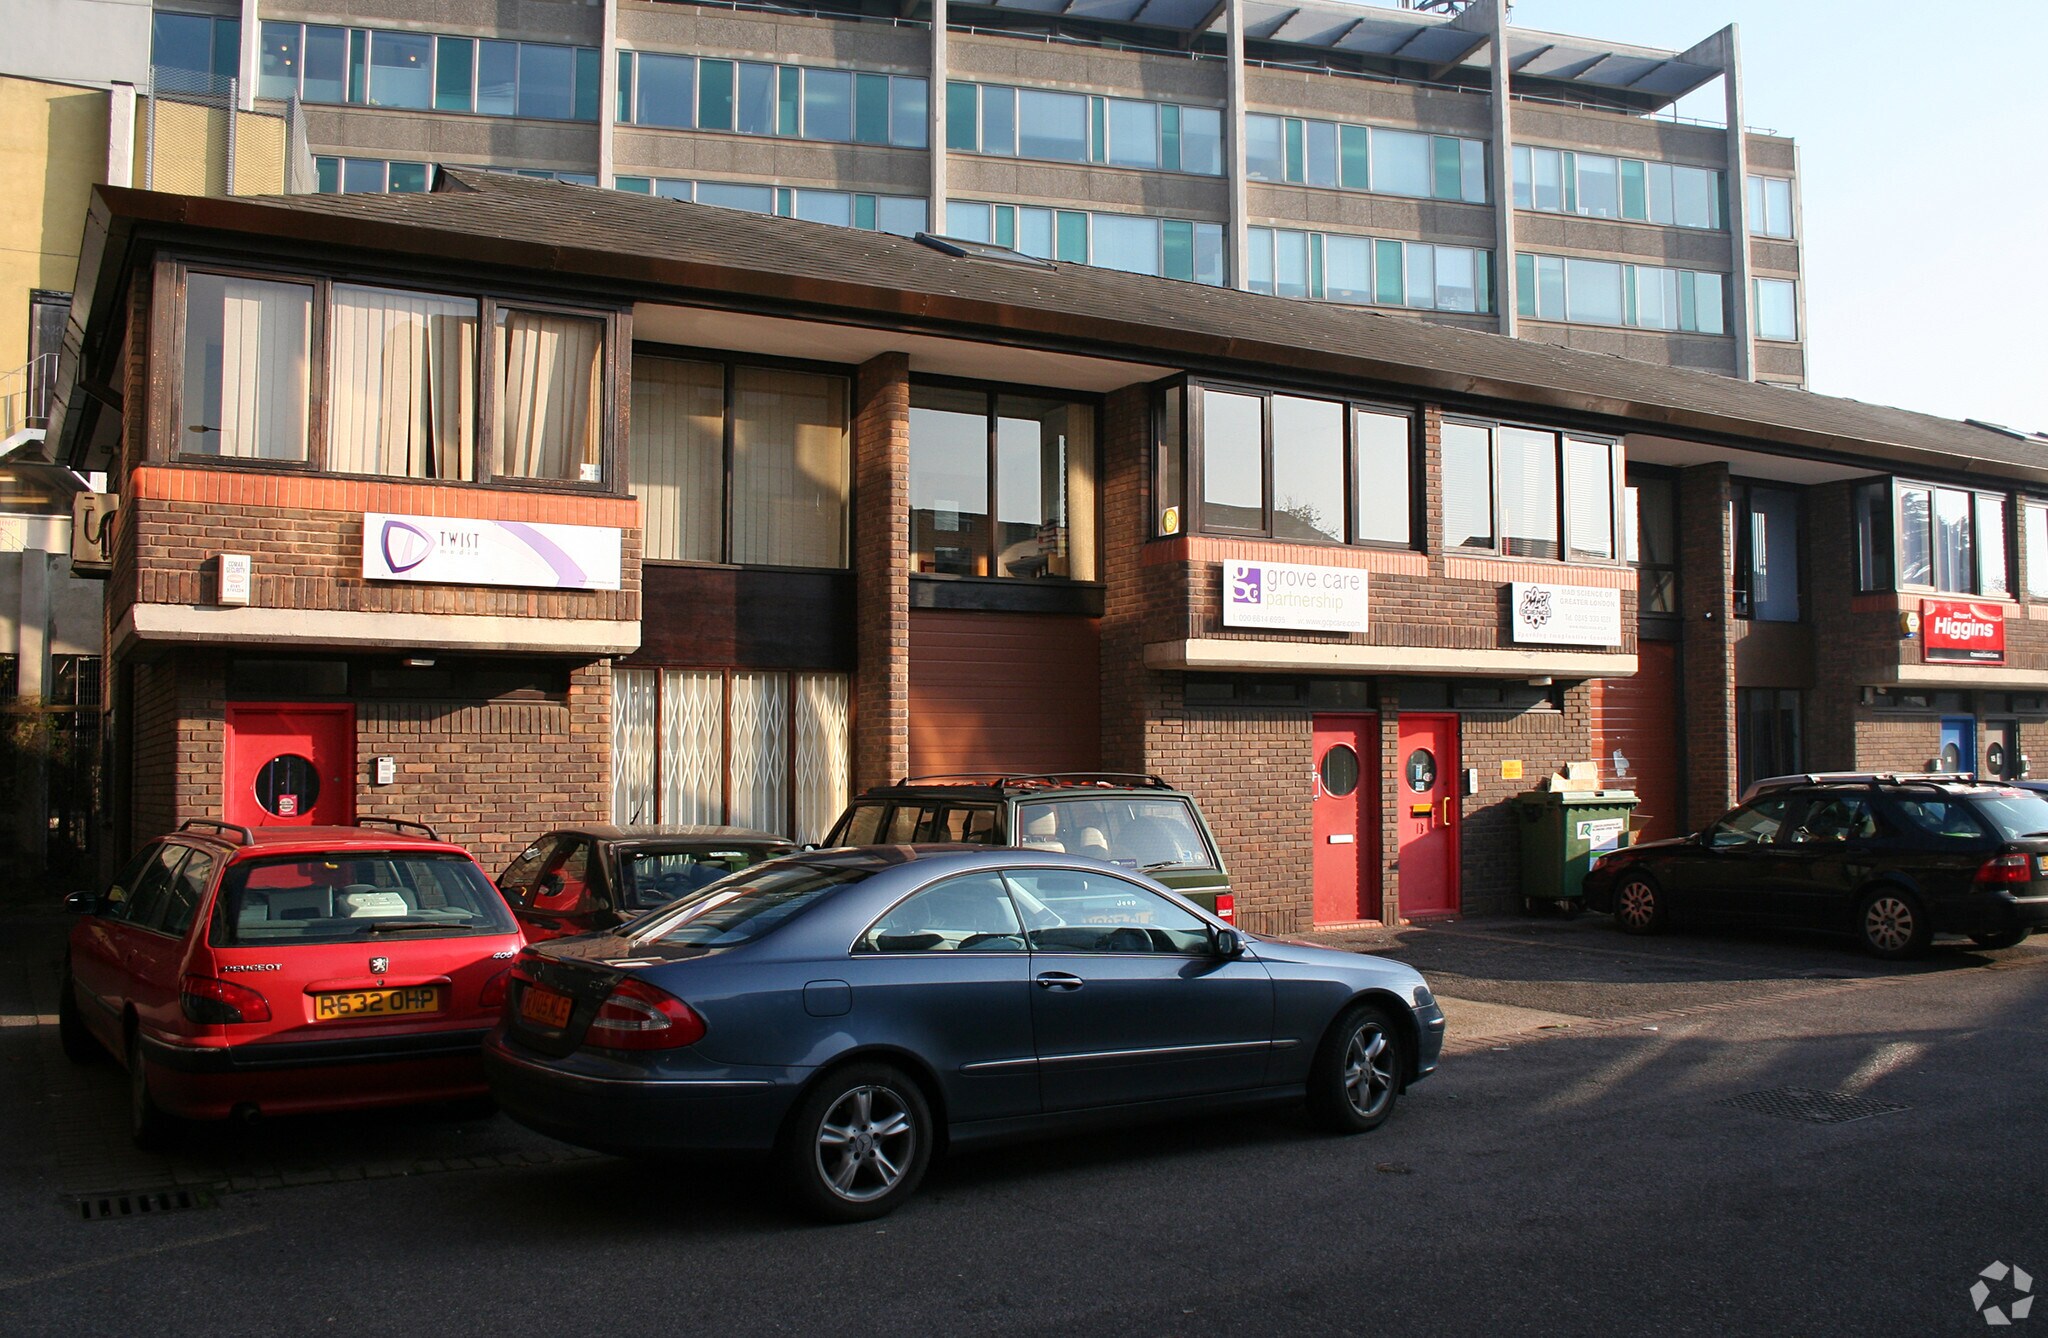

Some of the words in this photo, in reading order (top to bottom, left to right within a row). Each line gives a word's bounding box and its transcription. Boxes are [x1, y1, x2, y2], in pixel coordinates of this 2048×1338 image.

[440, 531, 479, 548] TWIST
[1267, 569, 1317, 592] grove
[1322, 573, 1360, 591] care
[1266, 591, 1343, 613] partnership
[1560, 598, 1588, 606] GREATER
[1590, 599, 1615, 608] LONDON
[1934, 617, 1994, 640] Higgins
[1116, 899, 1136, 907] Jeep
[224, 963, 282, 972] PEUGEOT
[321, 993, 383, 1015] R632
[390, 990, 433, 1010] OHP
